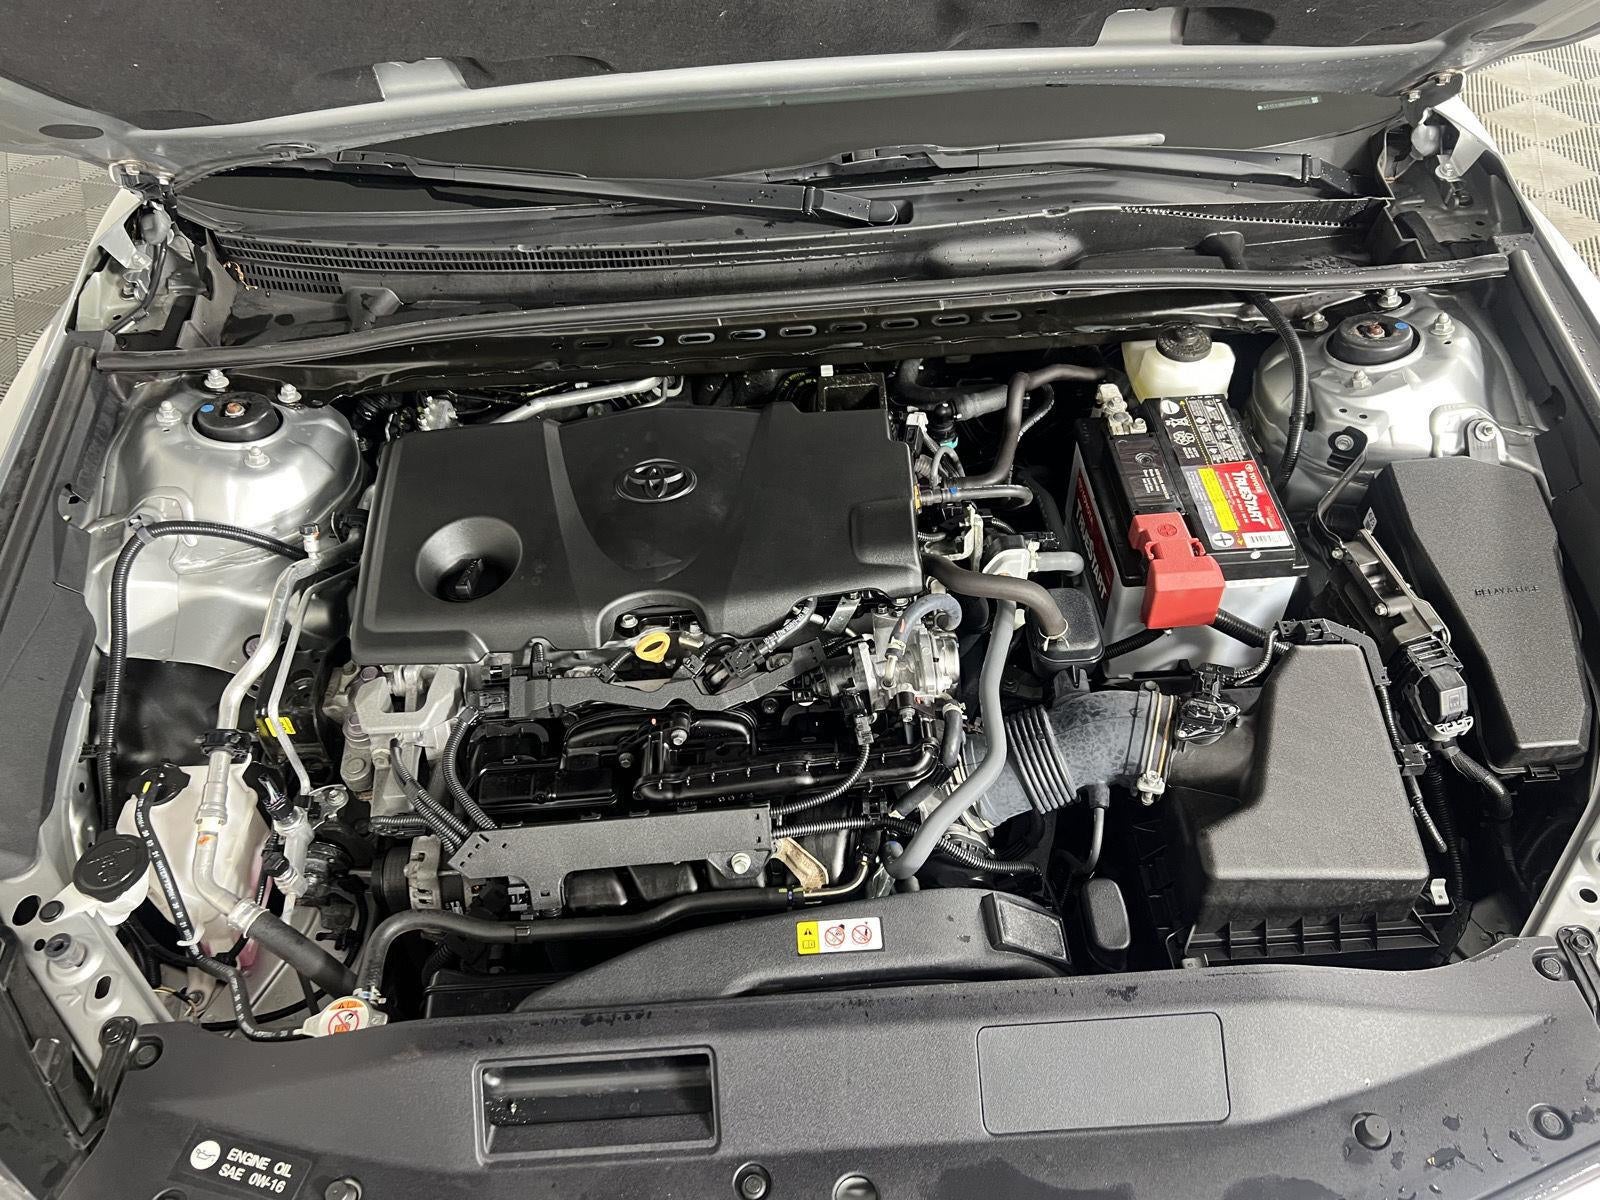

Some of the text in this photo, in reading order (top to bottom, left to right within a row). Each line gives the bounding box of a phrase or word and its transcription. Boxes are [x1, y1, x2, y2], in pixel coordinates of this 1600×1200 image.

[1231, 470, 1266, 526] TRUESTART
[1077, 498, 1108, 600] TRUESTART
[218, 1163, 287, 1194] SAE 0W-16
[227, 1147, 292, 1178] ENGINE OIL
